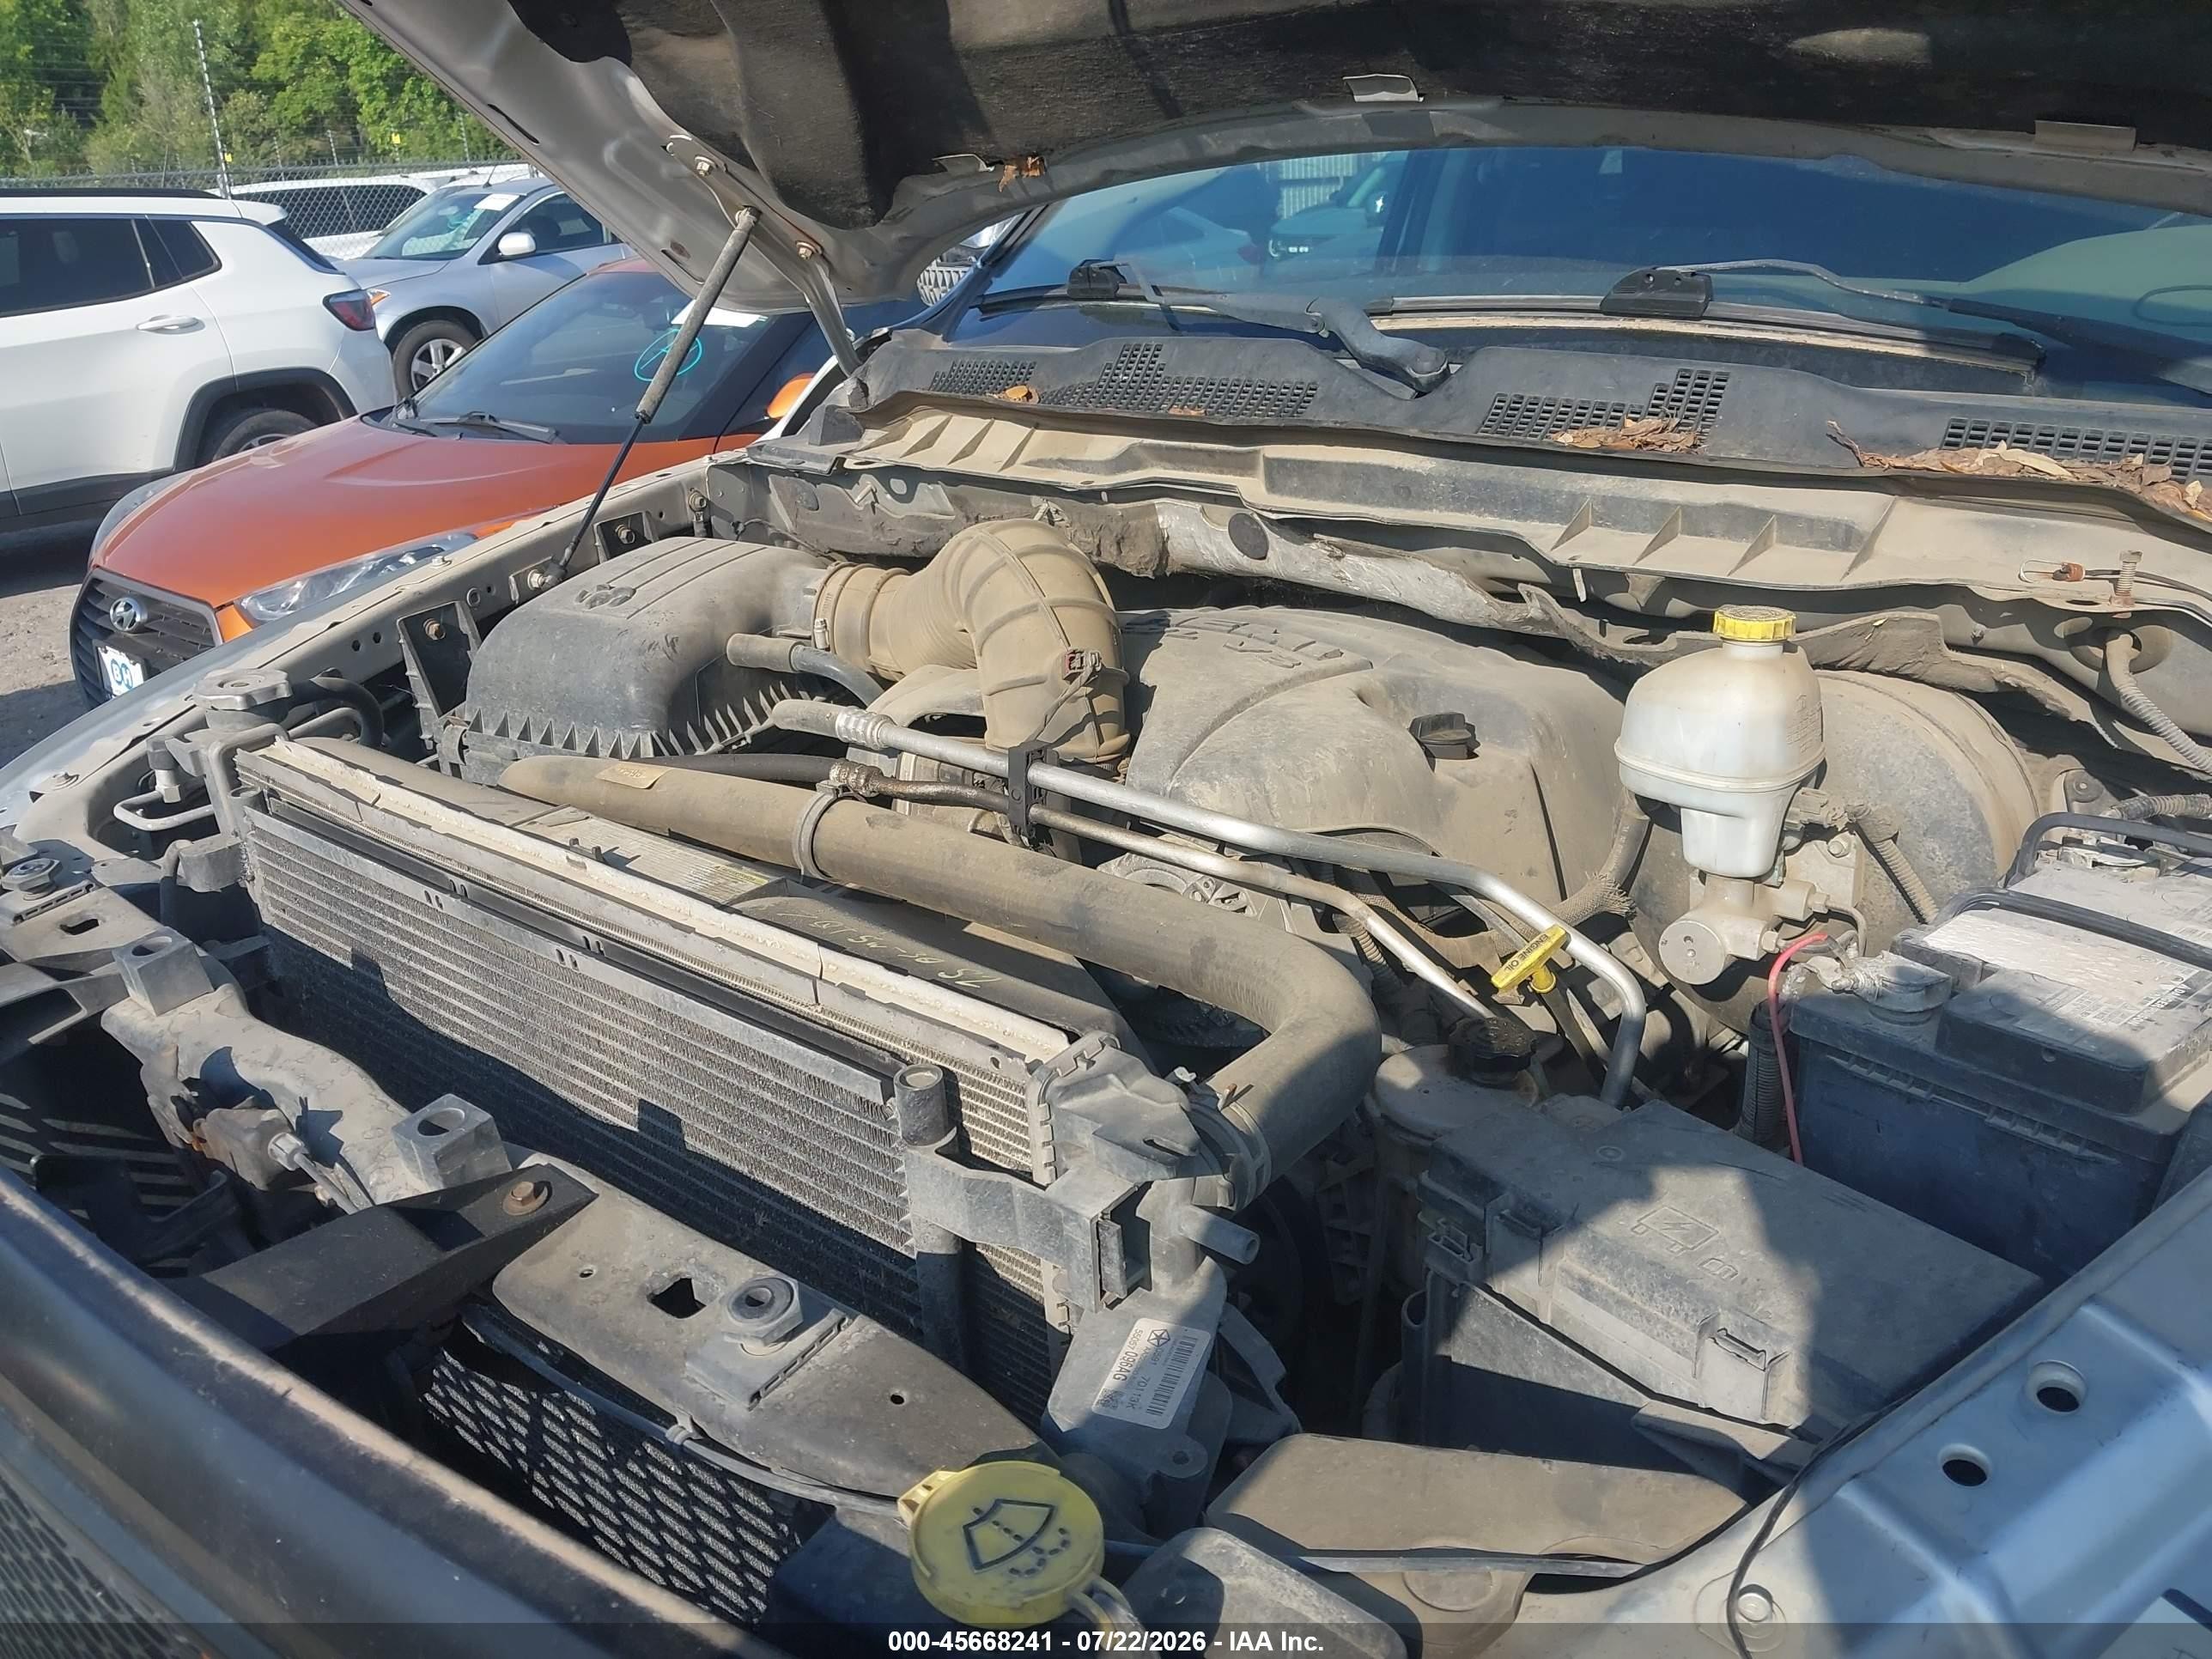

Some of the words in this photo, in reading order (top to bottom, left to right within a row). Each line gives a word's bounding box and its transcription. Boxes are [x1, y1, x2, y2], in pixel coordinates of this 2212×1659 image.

[1517, 934, 1548, 961] ENGINE
[1504, 959, 1519, 971] OIL
[1112, 1351, 1139, 1382] 096AG
